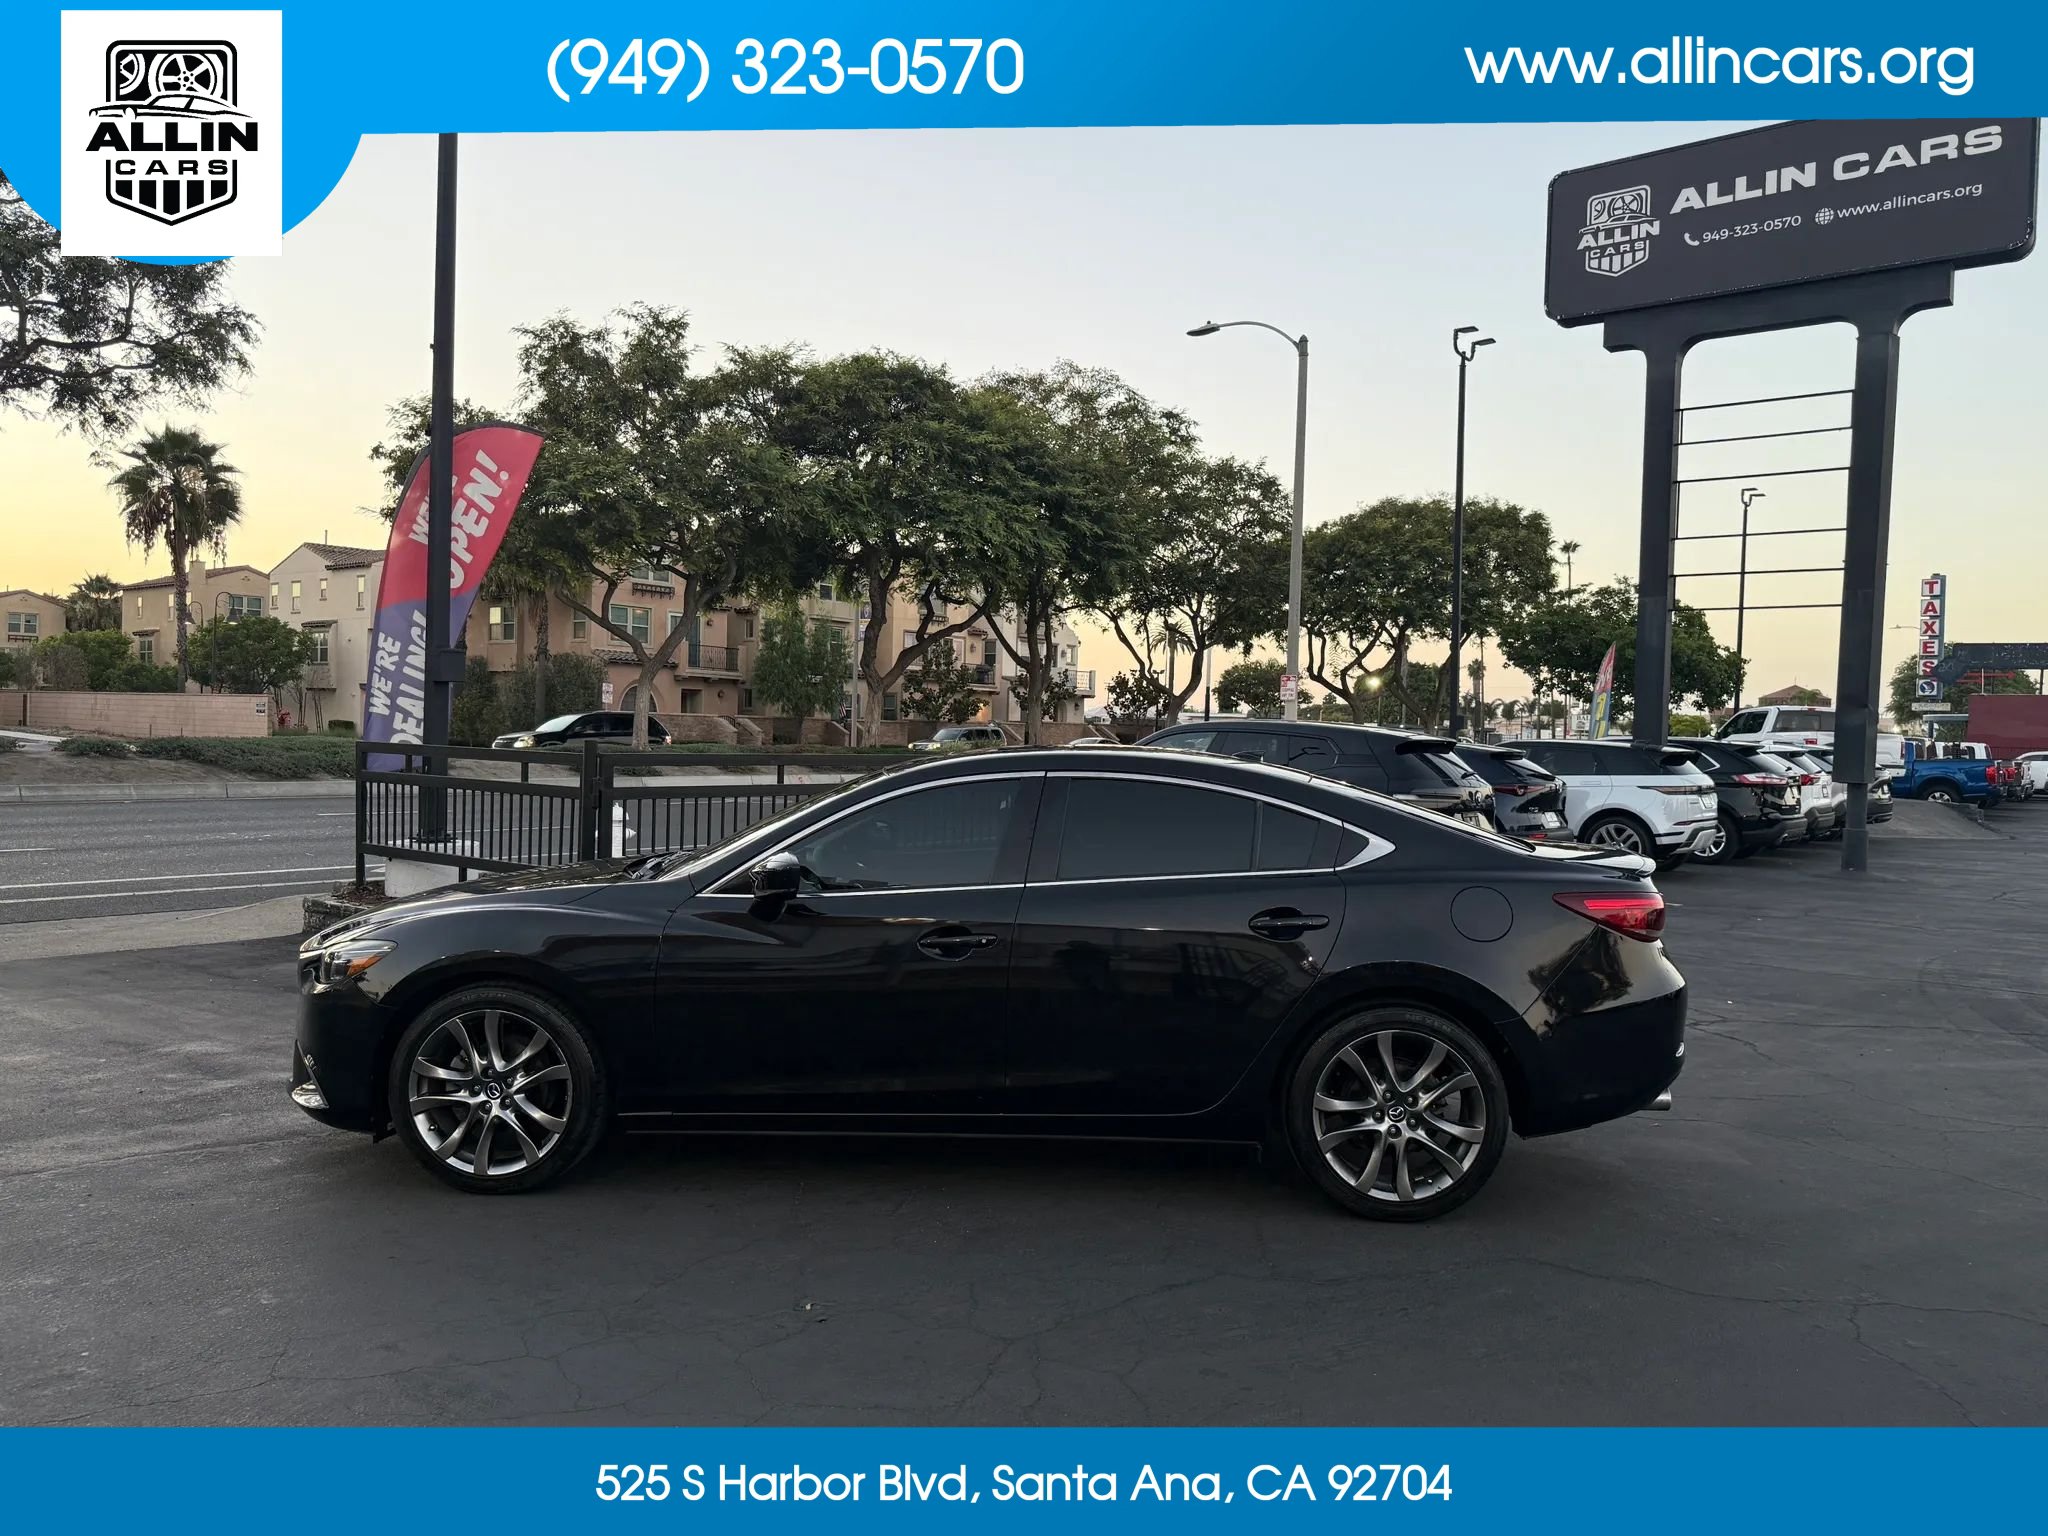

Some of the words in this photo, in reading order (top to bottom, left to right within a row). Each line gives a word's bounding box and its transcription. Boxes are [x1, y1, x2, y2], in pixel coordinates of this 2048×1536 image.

[1670, 162, 1816, 214] ALLIN
[1833, 125, 2002, 180] CARS
[1577, 220, 1660, 250] ALLIN
[1702, 215, 1801, 243] 949-323-0570
[1837, 183, 1982, 218] www.allincars.org
[1590, 241, 1644, 258] CARS
[1922, 580, 1938, 677] TAXES
[369, 632, 401, 716] WE'RE
